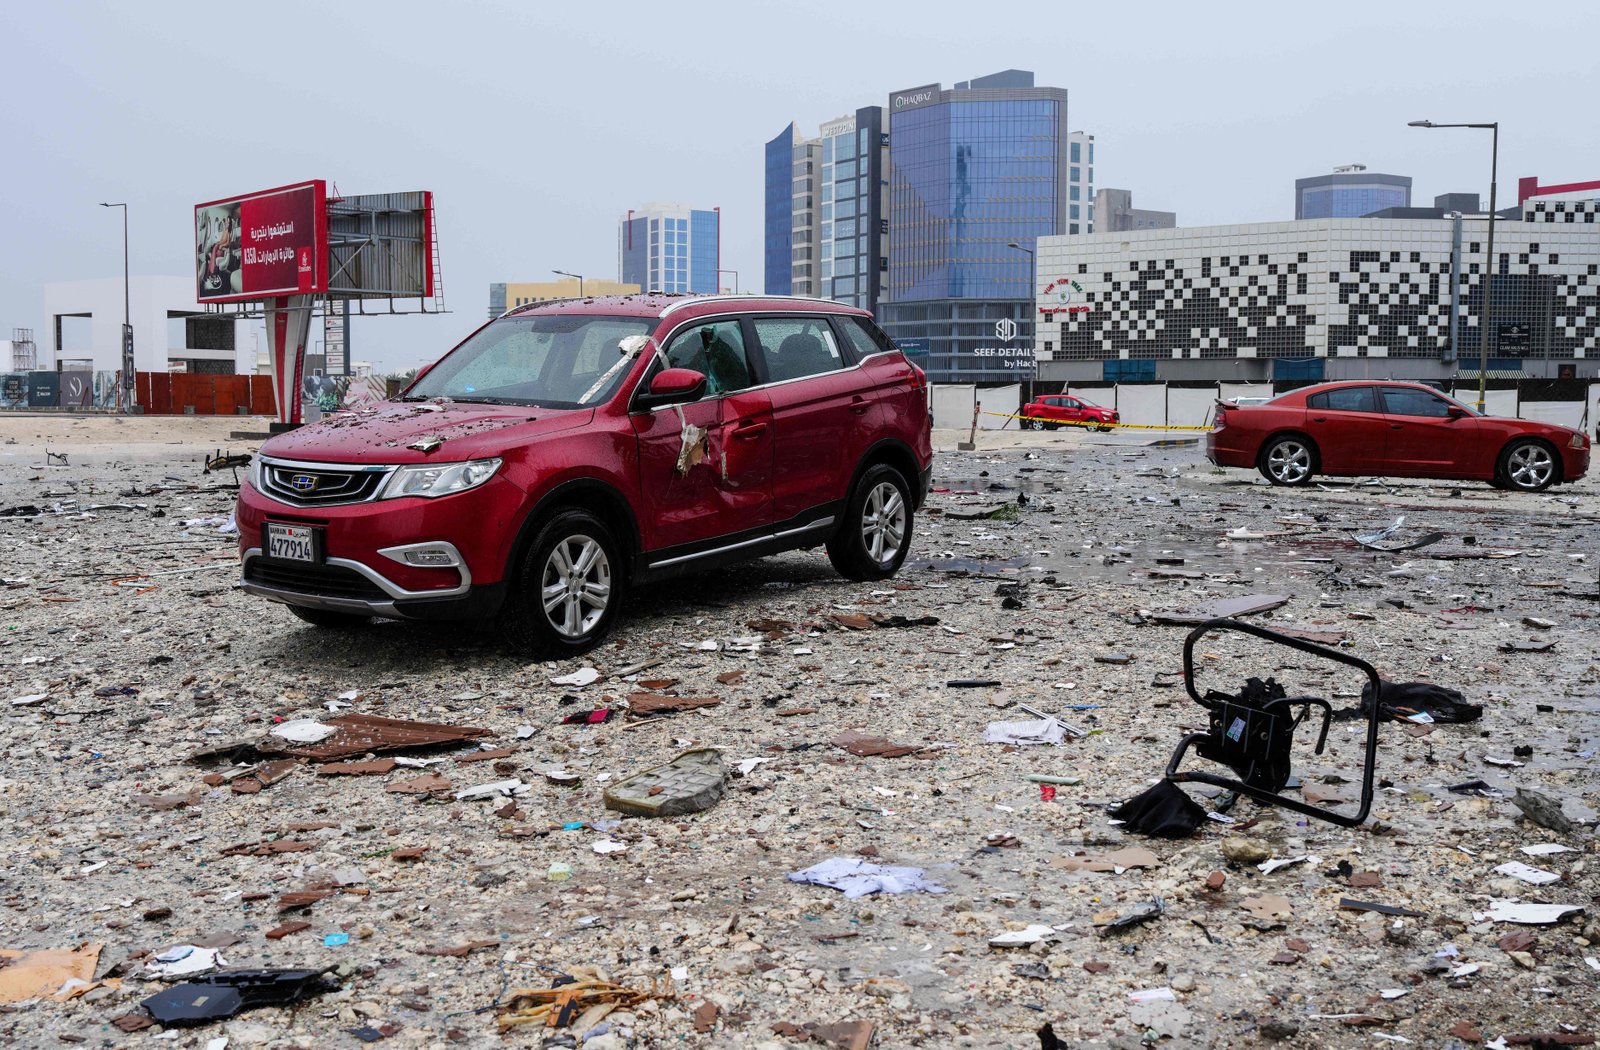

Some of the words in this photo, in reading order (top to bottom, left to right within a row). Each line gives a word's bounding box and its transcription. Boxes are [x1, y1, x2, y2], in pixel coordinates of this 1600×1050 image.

[903, 91, 932, 105] HAQBAZ
[824, 121, 856, 137] WESTPOIN
[250, 225, 268, 242] بتجربة
[267, 220, 295, 240] استمتعوا
[279, 246, 295, 263] طائرة
[974, 348, 997, 357] SEEF
[1004, 360, 1015, 369] by
[270, 526, 288, 535] BAHRAIN
[271, 537, 311, 560] 477914
